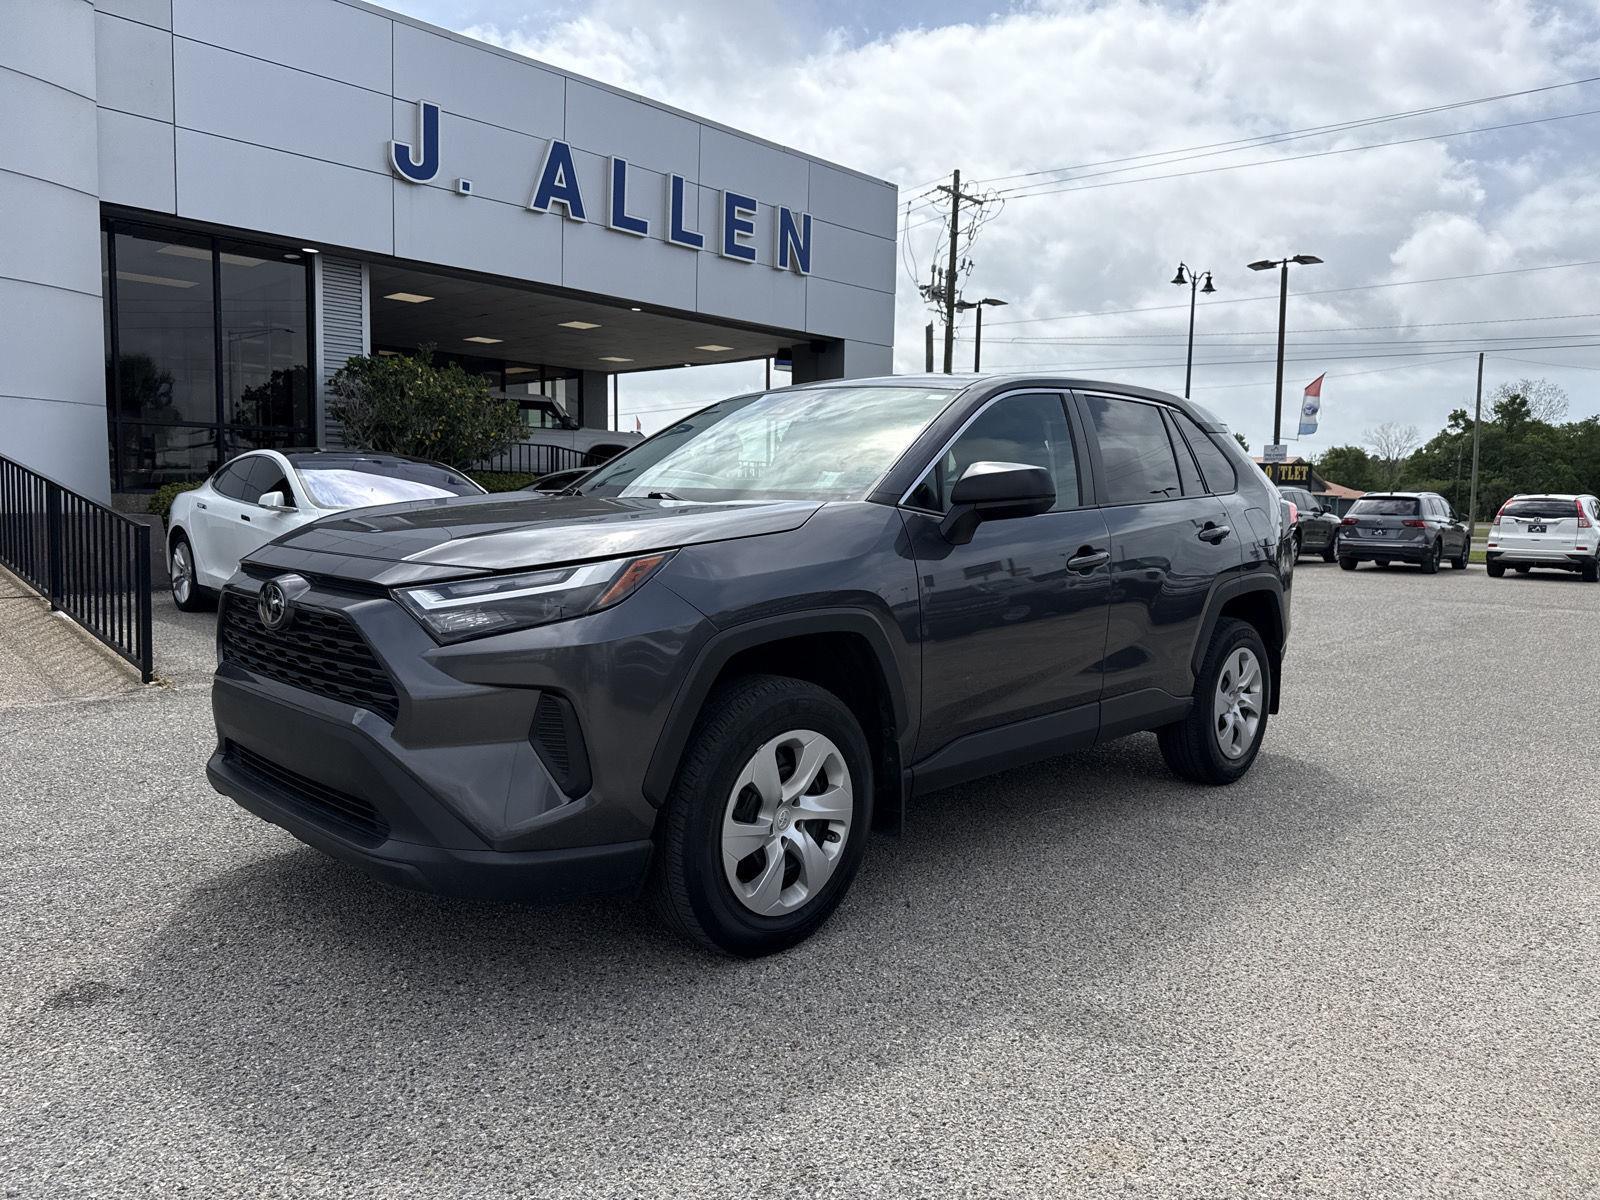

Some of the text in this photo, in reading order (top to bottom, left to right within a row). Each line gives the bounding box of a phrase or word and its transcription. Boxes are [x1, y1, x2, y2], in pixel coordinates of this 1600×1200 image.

[388, 99, 814, 276] J. ALLEN
[1265, 464, 1309, 481] OTLET
